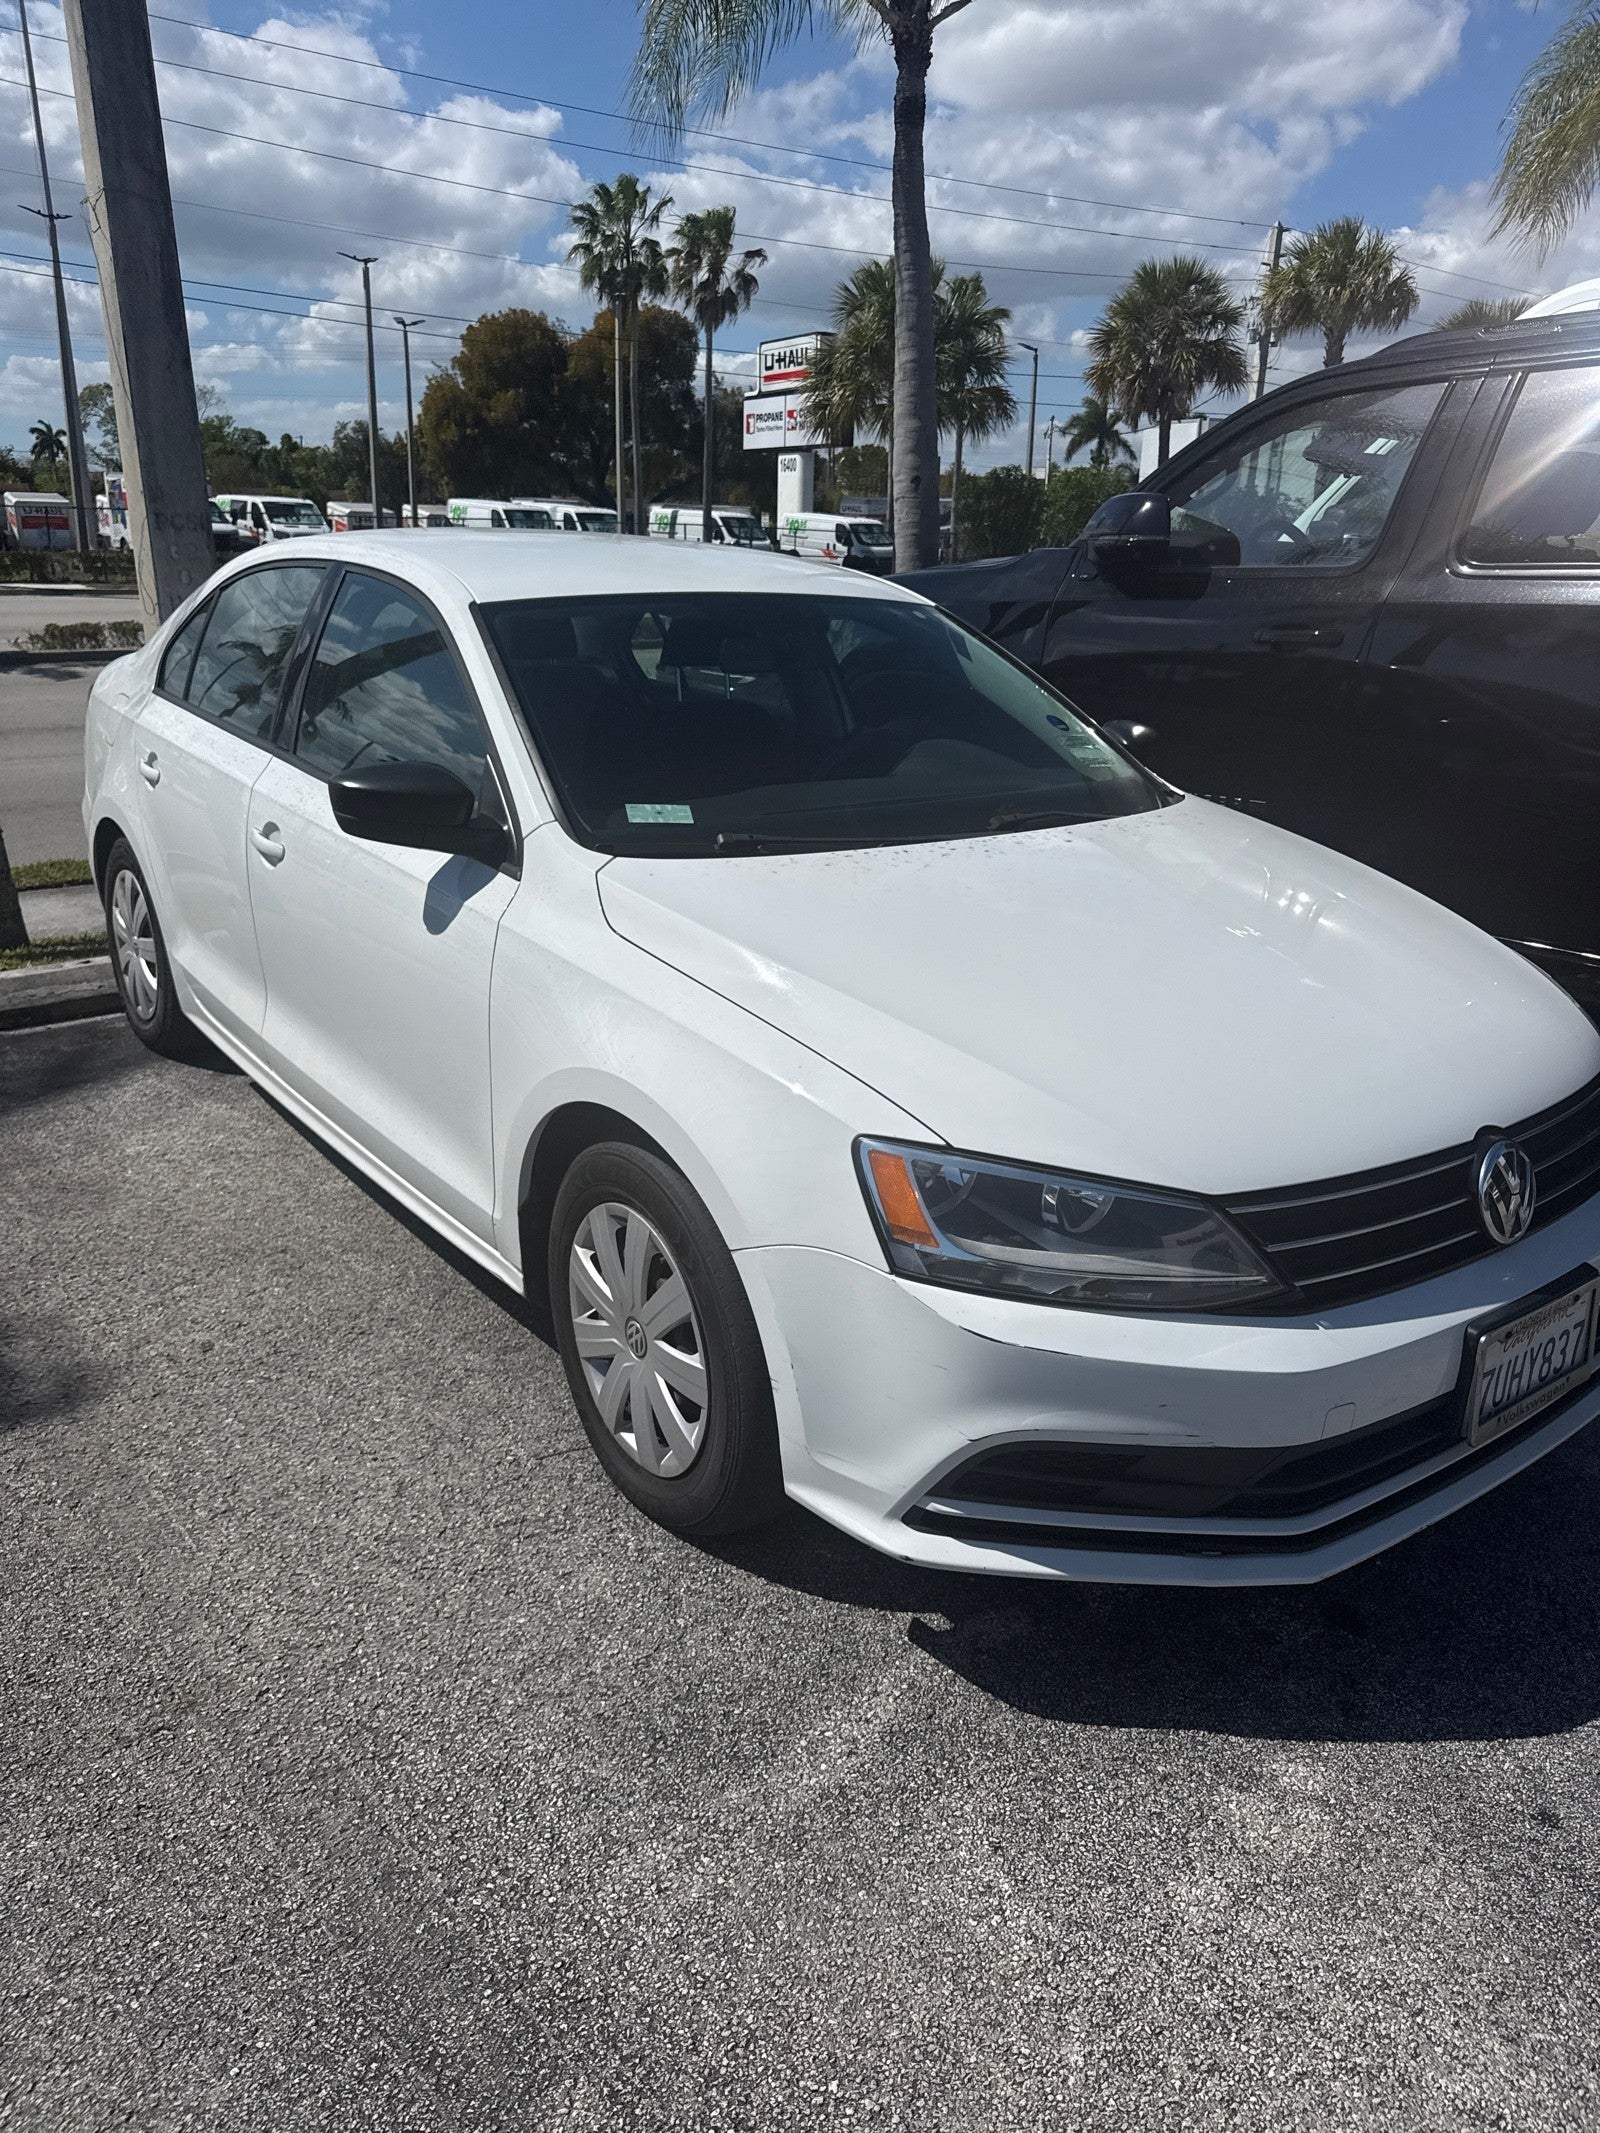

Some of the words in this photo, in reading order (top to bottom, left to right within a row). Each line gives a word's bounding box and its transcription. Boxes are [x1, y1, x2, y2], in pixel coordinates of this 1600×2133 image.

[756, 411, 783, 423] PROPANE
[780, 457, 797, 472] 16400
[1479, 1319, 1587, 1417] 7UHY837
